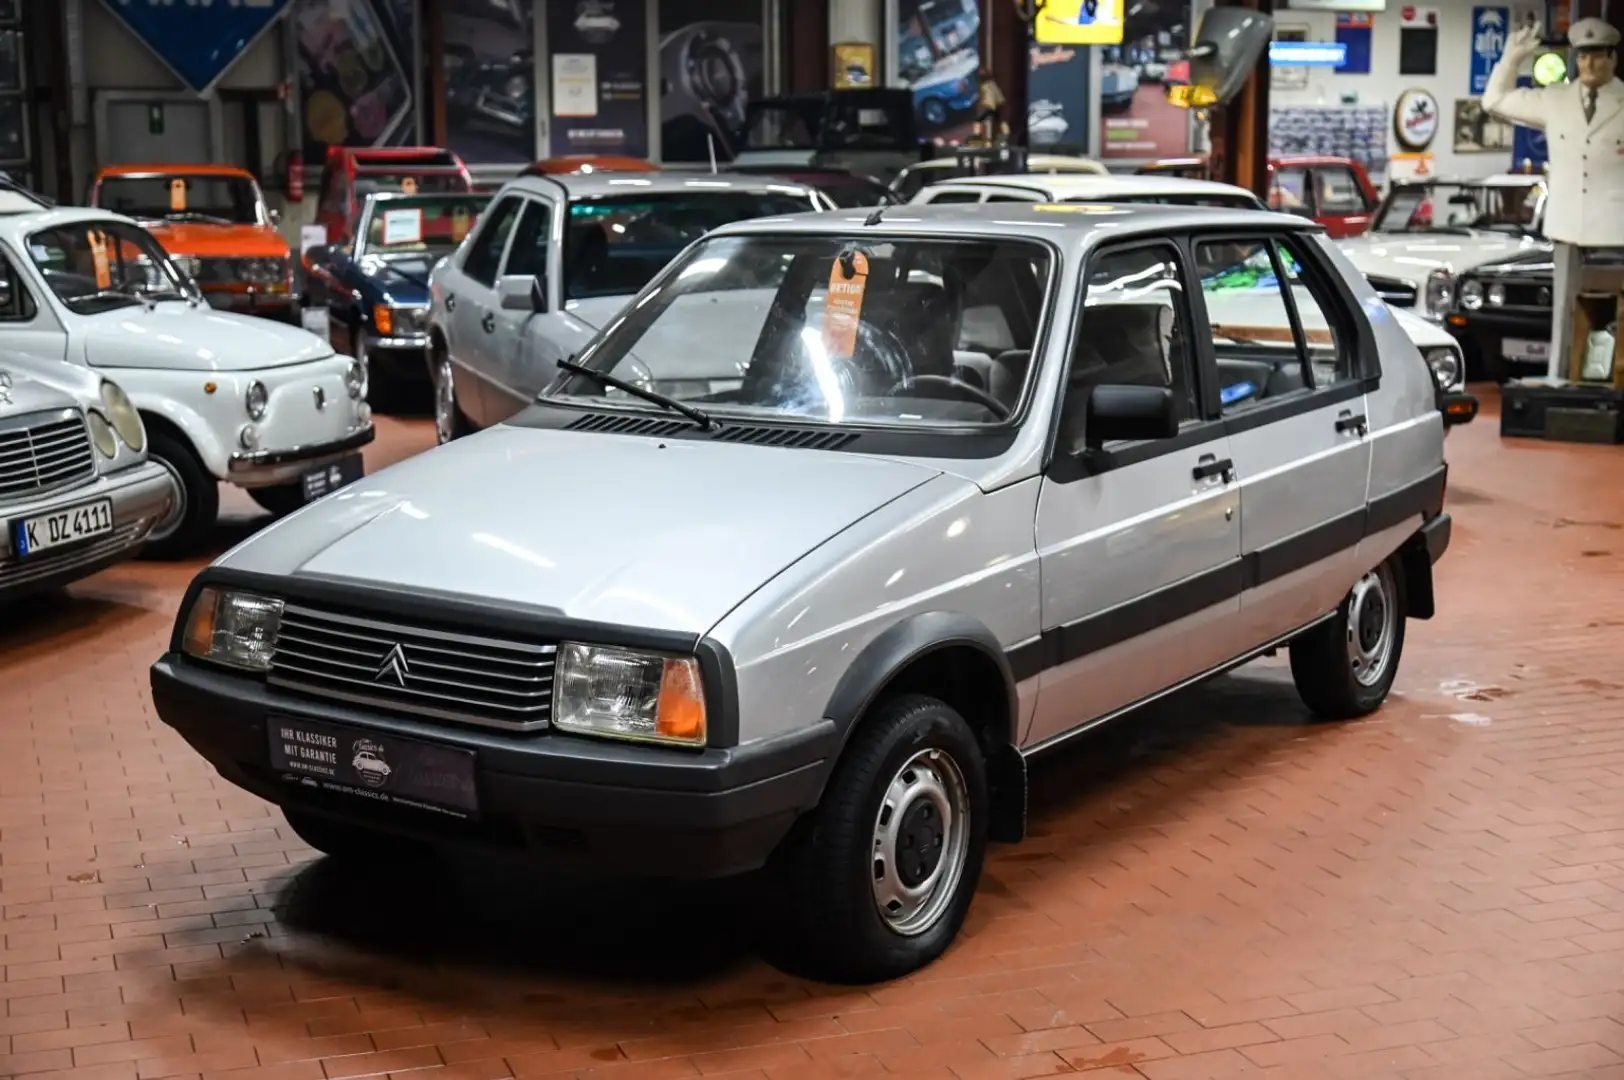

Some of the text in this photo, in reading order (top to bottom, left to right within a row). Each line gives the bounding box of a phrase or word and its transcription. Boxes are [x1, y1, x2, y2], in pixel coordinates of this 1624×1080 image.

[27, 504, 110, 548] K DZ 4111
[280, 728, 337, 748] IHR KLASSIKER
[284, 744, 336, 764] MIT GARANTIE
